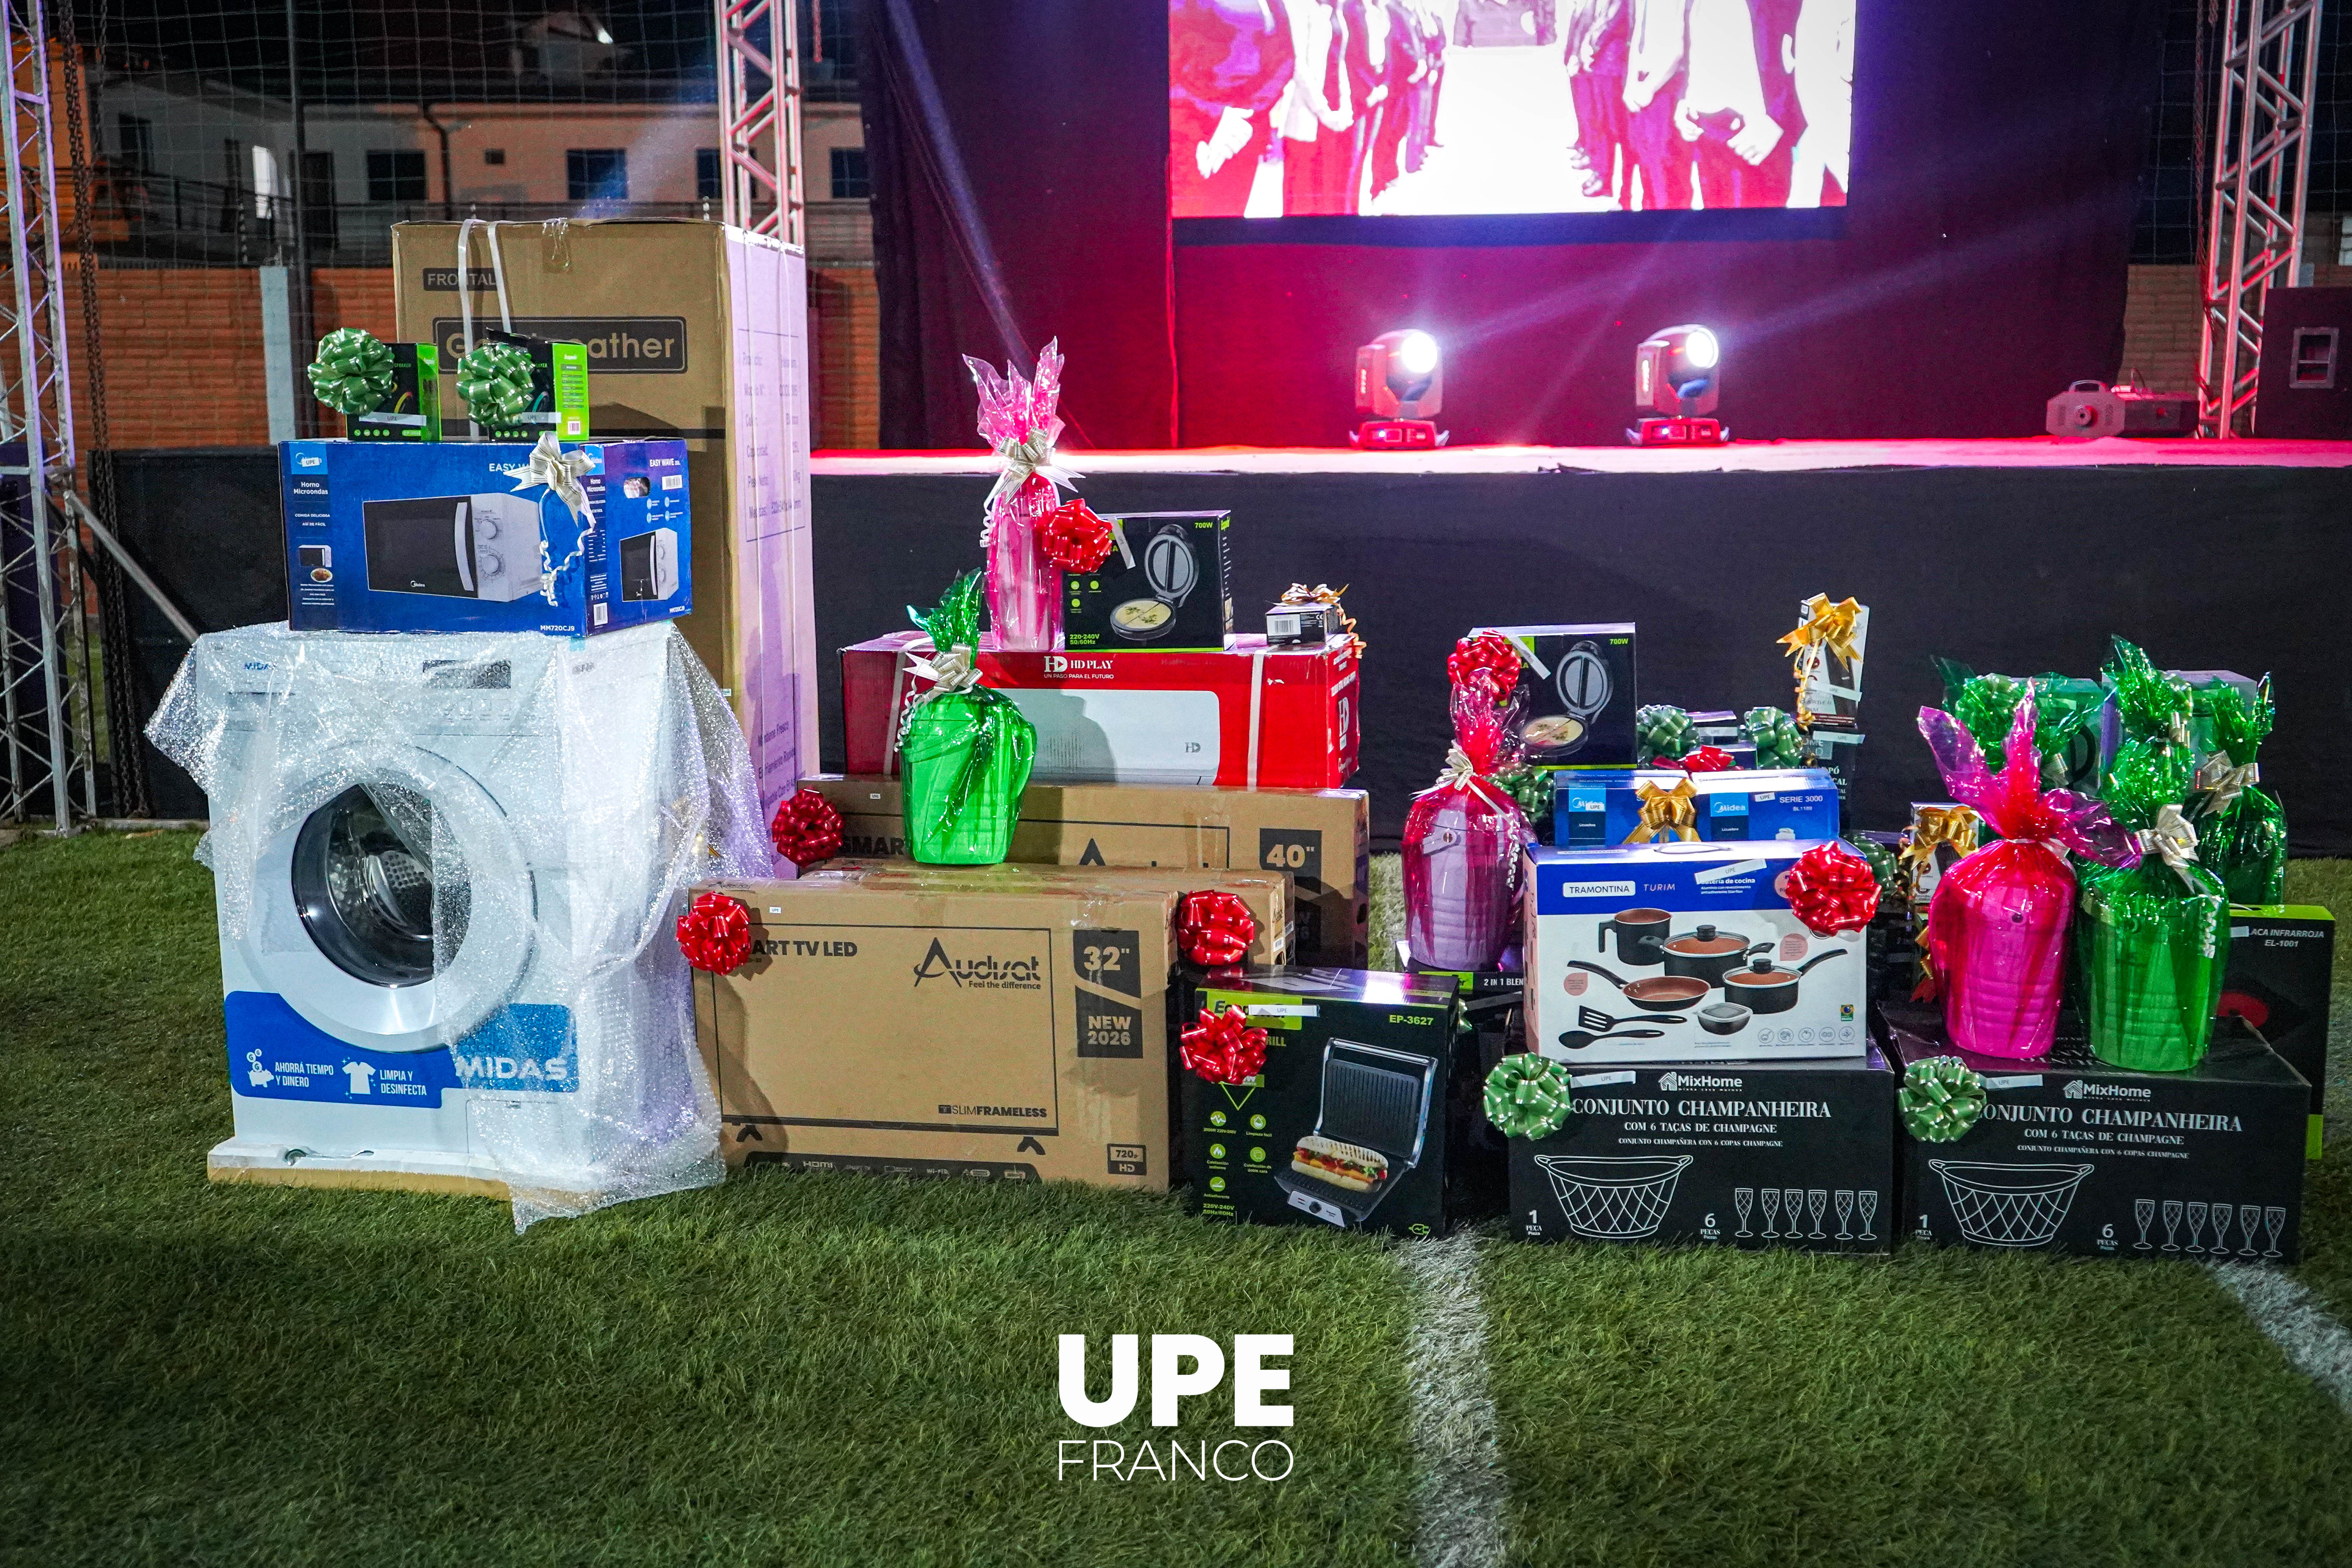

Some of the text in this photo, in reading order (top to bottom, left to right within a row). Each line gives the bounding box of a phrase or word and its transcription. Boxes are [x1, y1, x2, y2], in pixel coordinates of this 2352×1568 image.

[489, 463, 516, 472] EASY
[661, 458, 674, 466] WAVE
[1071, 659, 1085, 669] HD
[1087, 660, 1114, 670] PLAY
[1716, 803, 1746, 812] Midea
[842, 835, 905, 855] SMAR
[1266, 844, 1315, 867] 40"
[1569, 883, 1675, 894] TRAMONTINA TURIM
[2270, 929, 2324, 938] INFRARROJA
[751, 940, 858, 957] ART TV LED
[1083, 946, 1130, 971] 32"
[969, 980, 1041, 990] Feel the difference
[1087, 1015, 1132, 1031] NEW
[1389, 1014, 1434, 1026] EP-3627
[1087, 1031, 1131, 1046] 2026
[1266, 1035, 1287, 1047] RILL
[275, 1061, 334, 1075] AHORRÁ TIEMPO
[455, 1055, 568, 1081] MIDAS
[275, 1075, 310, 1088] Y DINERO
[379, 1069, 413, 1081] LIMPIA Y
[1678, 1074, 1743, 1087] MixHome
[381, 1083, 427, 1096] DESINFECTA
[2083, 1083, 2151, 1098] MixHome
[952, 1105, 1047, 1117] SLIMFRAMELESS
[1572, 1098, 1831, 1118] CONJUNTO CHAMPANHEIRA
[1982, 1104, 2242, 1132] ONJUNTO CHAMPANHEIRA
[1624, 1122, 1777, 1133] COM 6 TAÇAS DE CHAMPAGNE
[1653, 1137, 1697, 1146] CHAMPAÑERA
[2024, 1128, 2184, 1145] COM 6 TAÇAS DE CHAMPAGNE
[2053, 1145, 2099, 1154] CHAMPAÑERA
[2147, 1151, 2190, 1159] CHAMPAGNE
[1119, 1163, 1135, 1173] HD
[1529, 1210, 1538, 1224] 1
[1704, 1212, 1716, 1227] 6
[1919, 1214, 1928, 1228] 1
[2102, 1223, 2114, 1239] 6
